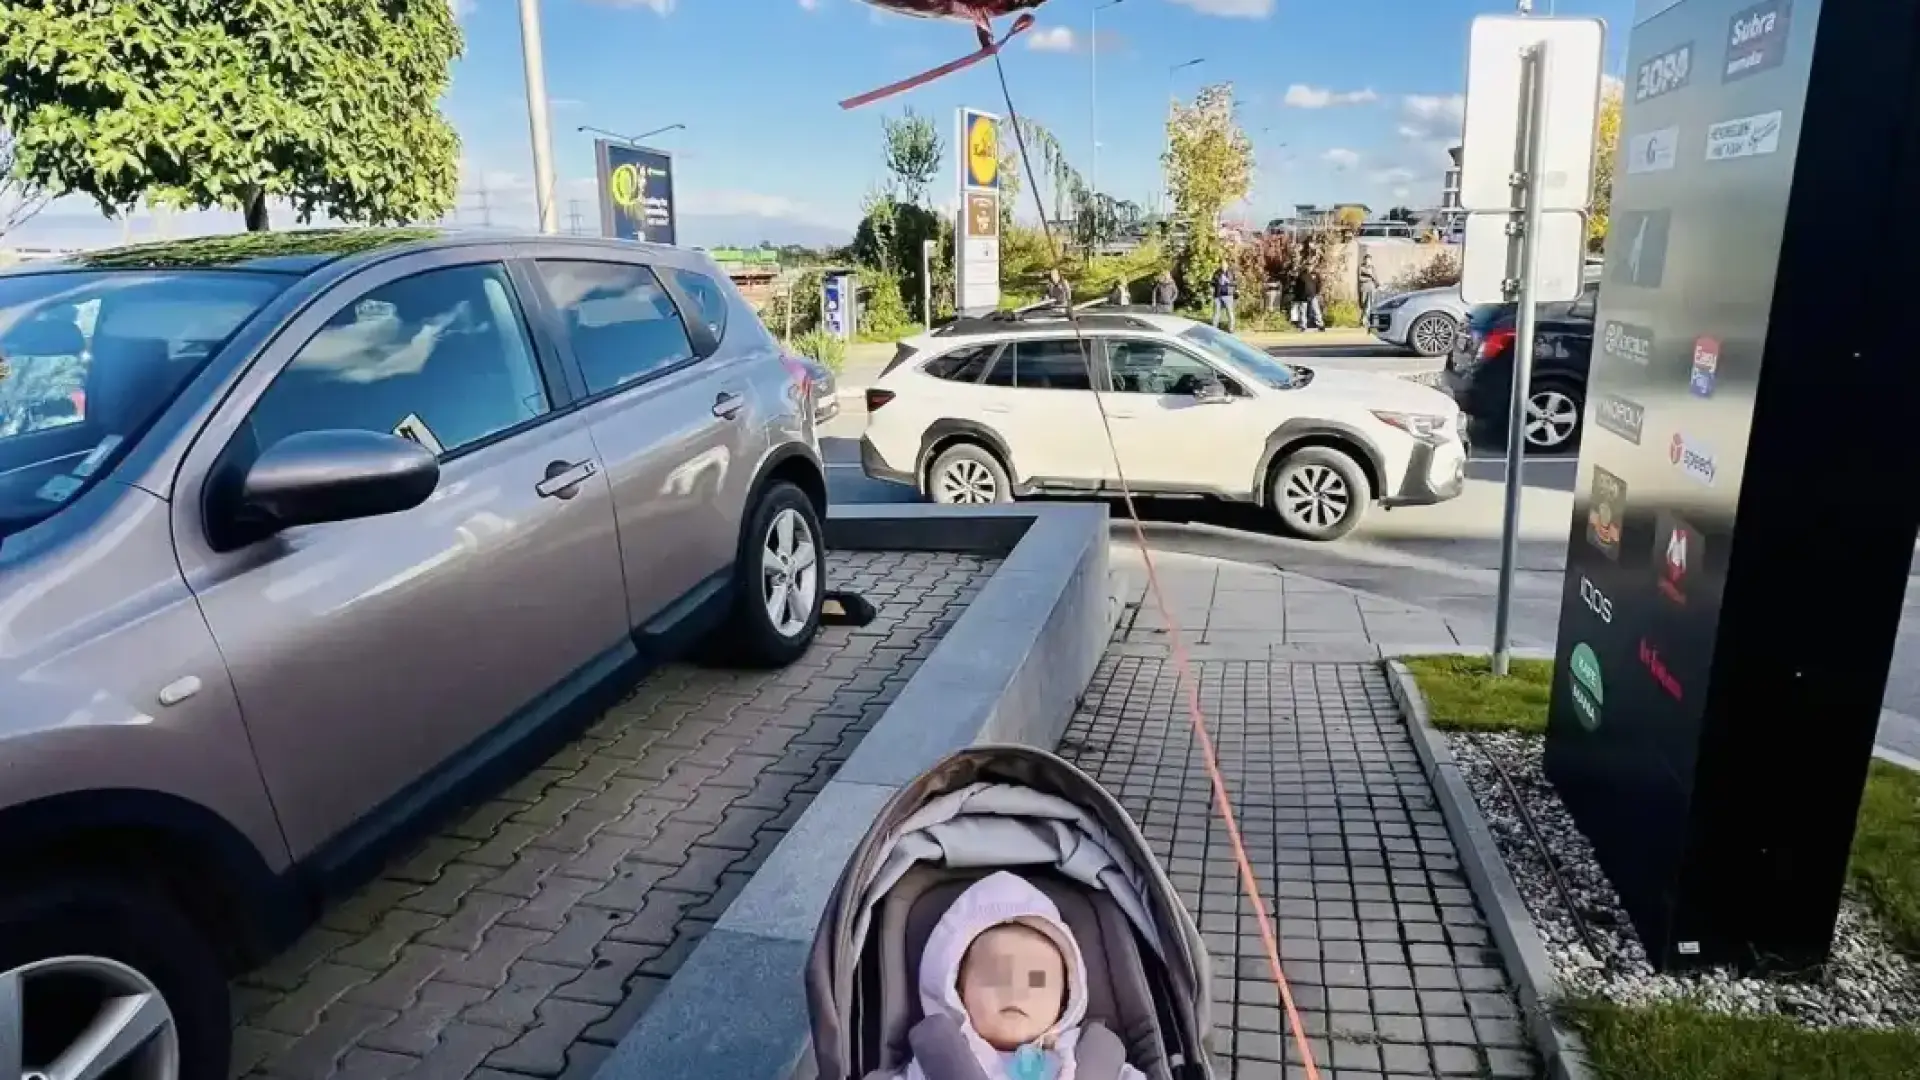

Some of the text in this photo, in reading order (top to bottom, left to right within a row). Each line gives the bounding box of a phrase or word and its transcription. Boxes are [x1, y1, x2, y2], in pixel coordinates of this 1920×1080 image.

[1694, 345, 1717, 373] Easy
[1684, 449, 1715, 482] speedy
[1580, 576, 1612, 623] IQOS
